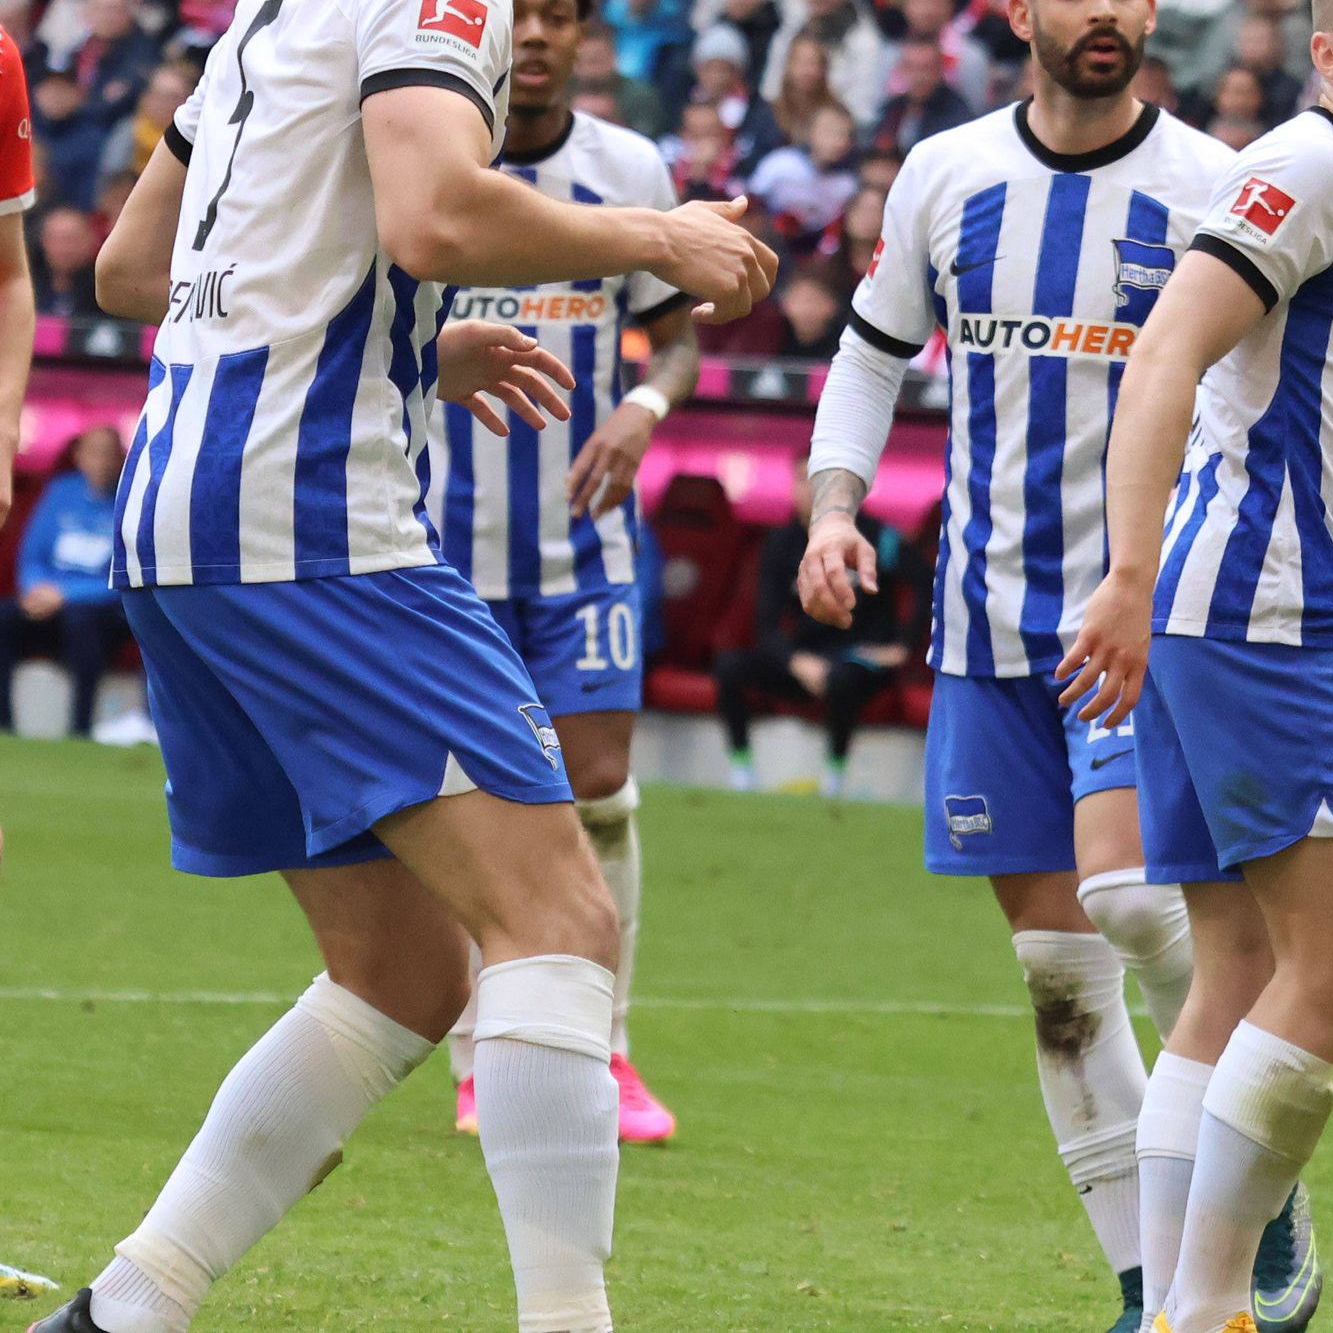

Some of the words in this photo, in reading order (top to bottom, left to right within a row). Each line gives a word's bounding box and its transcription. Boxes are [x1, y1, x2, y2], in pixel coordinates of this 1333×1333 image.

[415, 34, 478, 61] BUNDESLIGA
[450, 296, 605, 320] UTOHERO
[960, 318, 1137, 357] AUTOHER
[575, 603, 634, 671] 10
